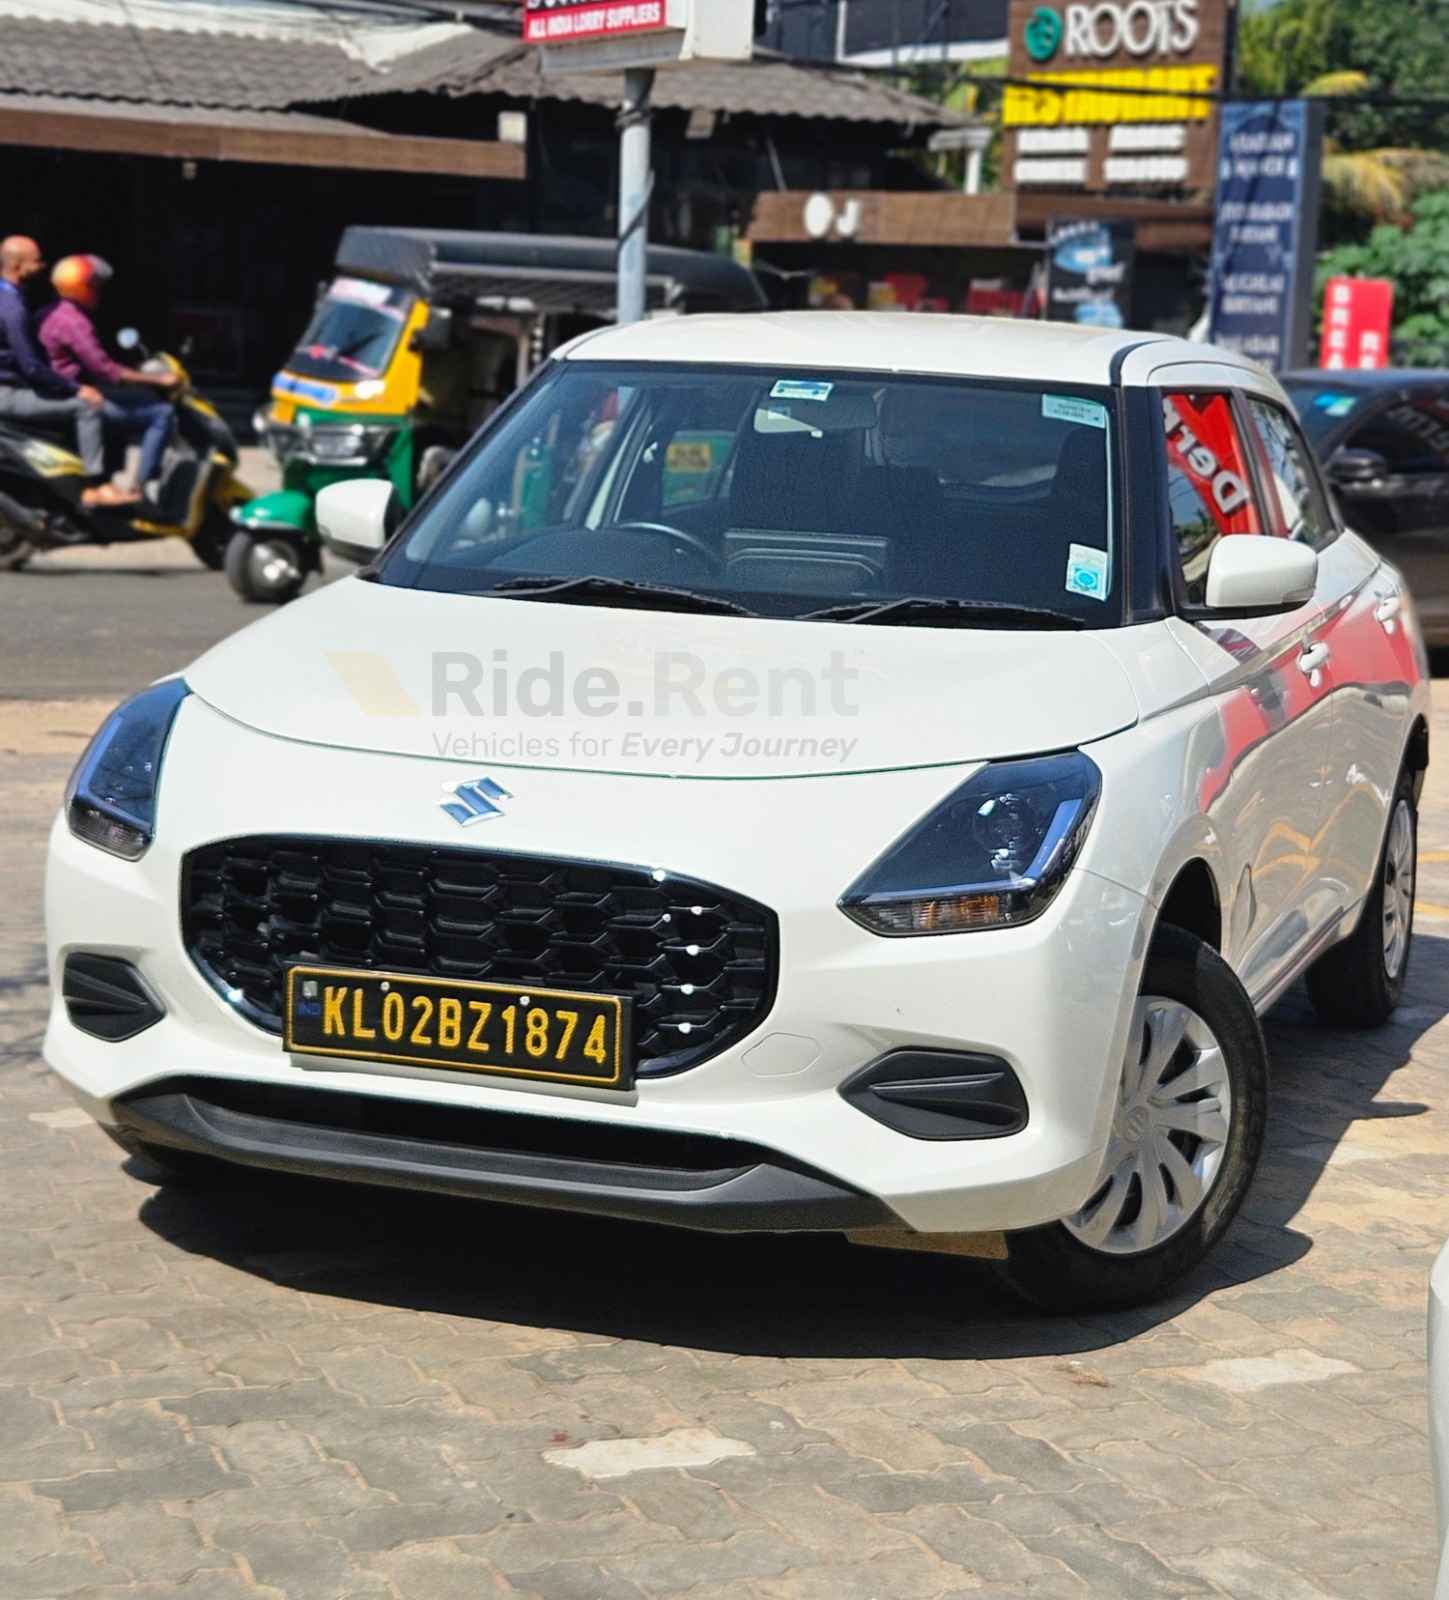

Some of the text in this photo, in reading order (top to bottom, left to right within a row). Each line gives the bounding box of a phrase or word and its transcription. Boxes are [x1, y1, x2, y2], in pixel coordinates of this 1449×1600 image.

[606, 2, 661, 29] SUPPLIERS
[1066, 0, 1199, 56] ROOTS
[323, 985, 607, 1064] KL02BZ1874
